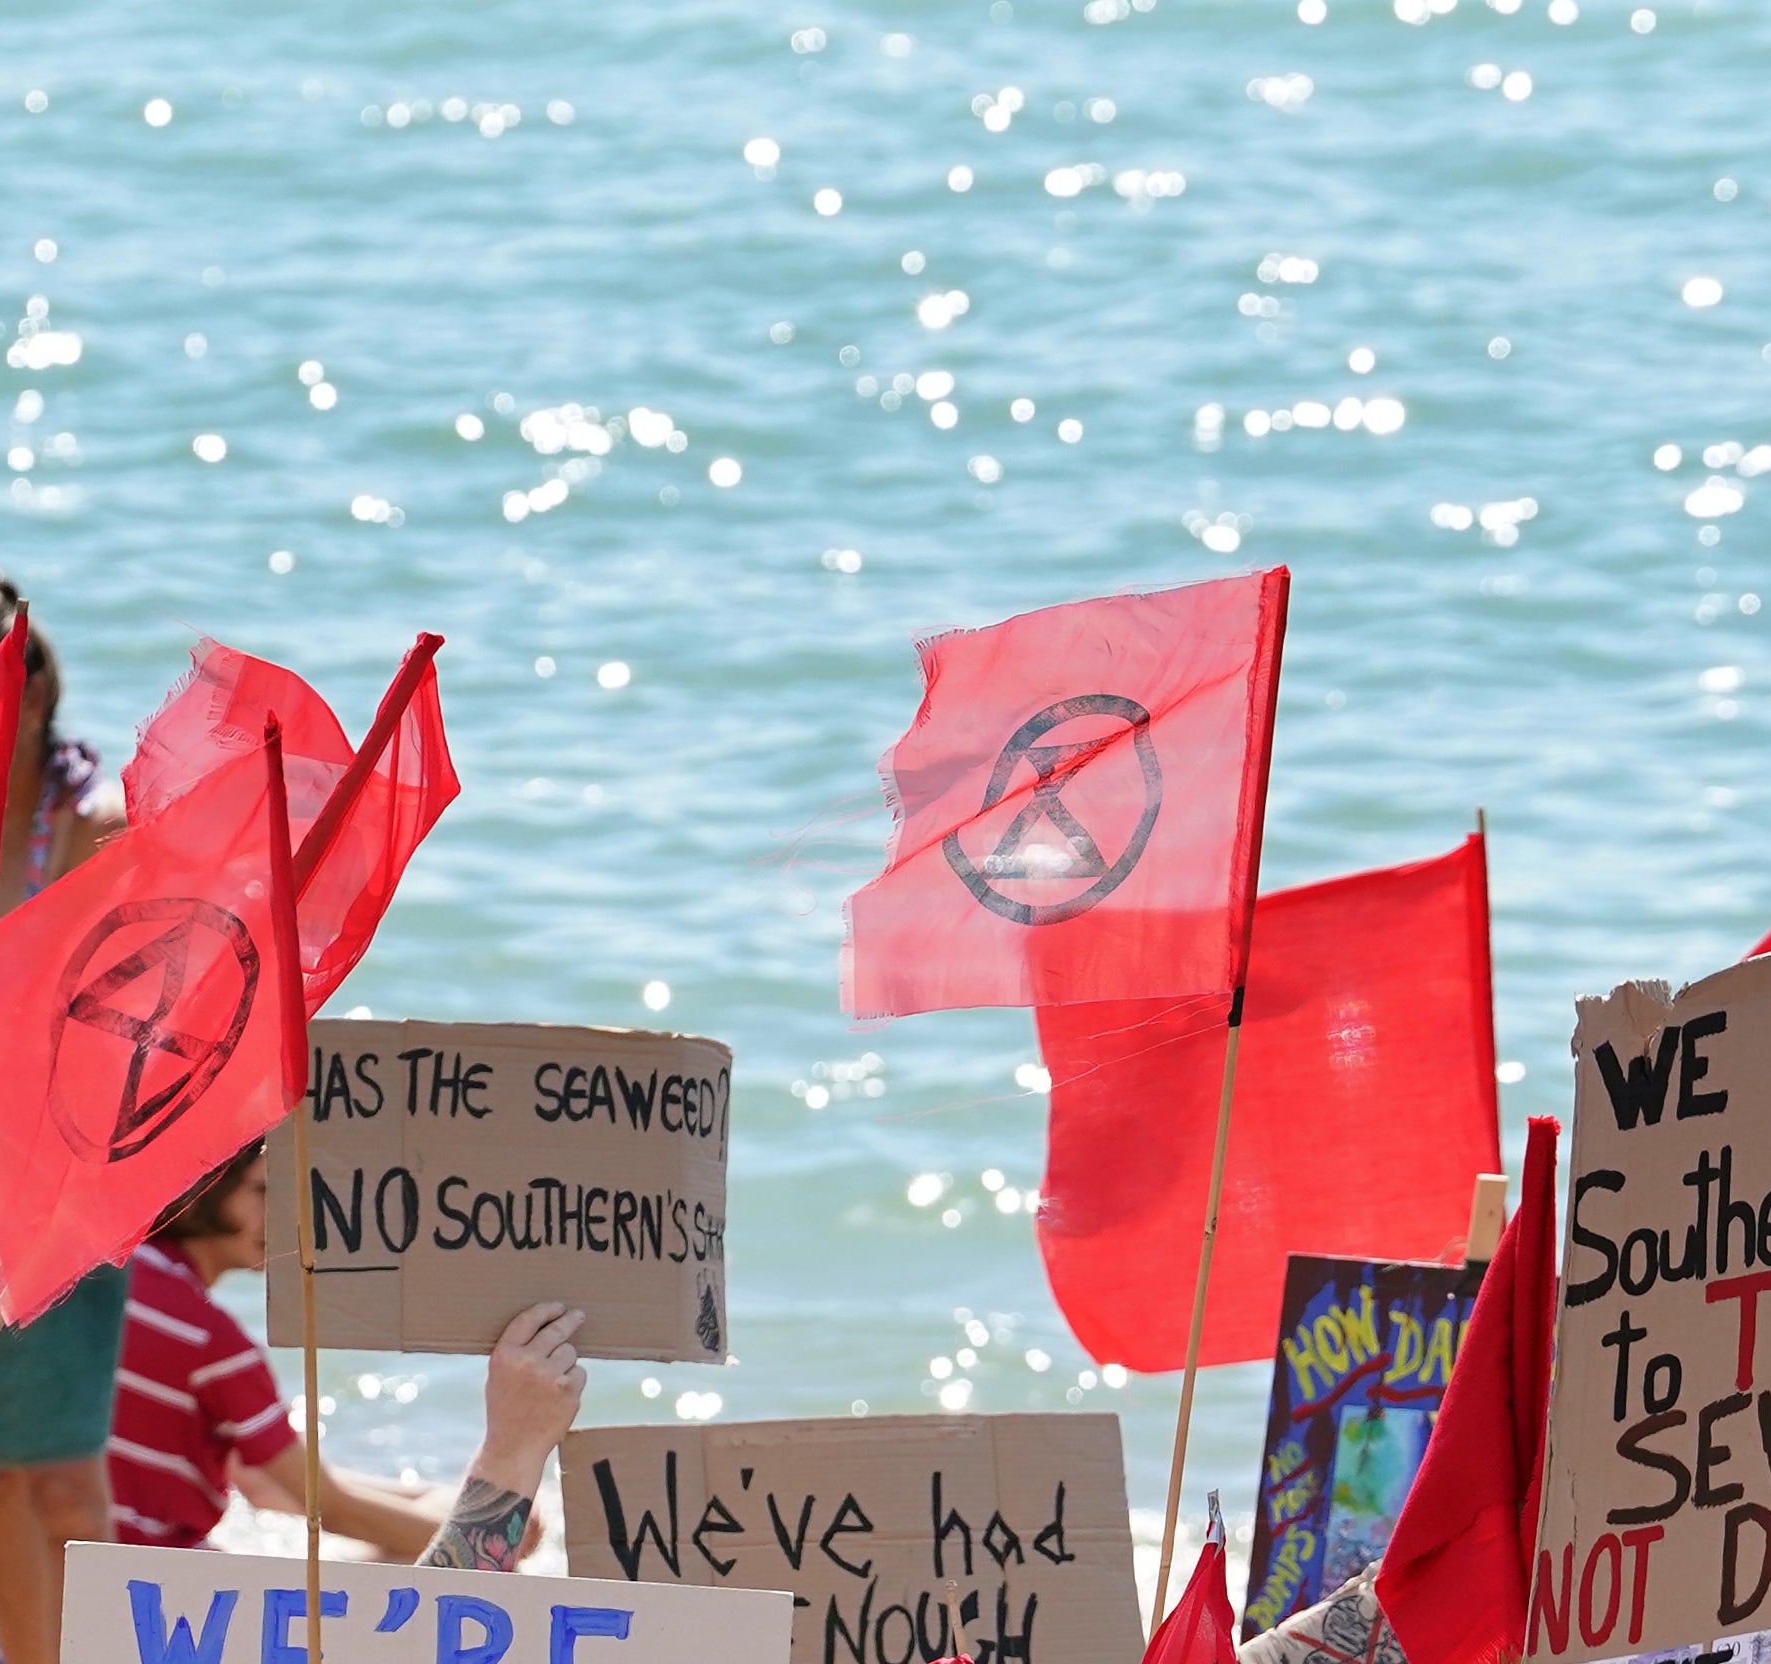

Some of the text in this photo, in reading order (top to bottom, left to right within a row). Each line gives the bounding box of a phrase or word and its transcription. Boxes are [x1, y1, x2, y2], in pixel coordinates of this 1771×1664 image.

[397, 1047, 494, 1119] THE
[1594, 1011, 1728, 1131] WE
[311, 1166, 419, 1253] NO
[433, 1176, 689, 1263] SOUTHERN'S
[1282, 1284, 1380, 1401] HOW
[1601, 1311, 1682, 1422] to
[592, 1450, 1076, 1581] We've had
[1528, 1525, 1664, 1656] NOT
